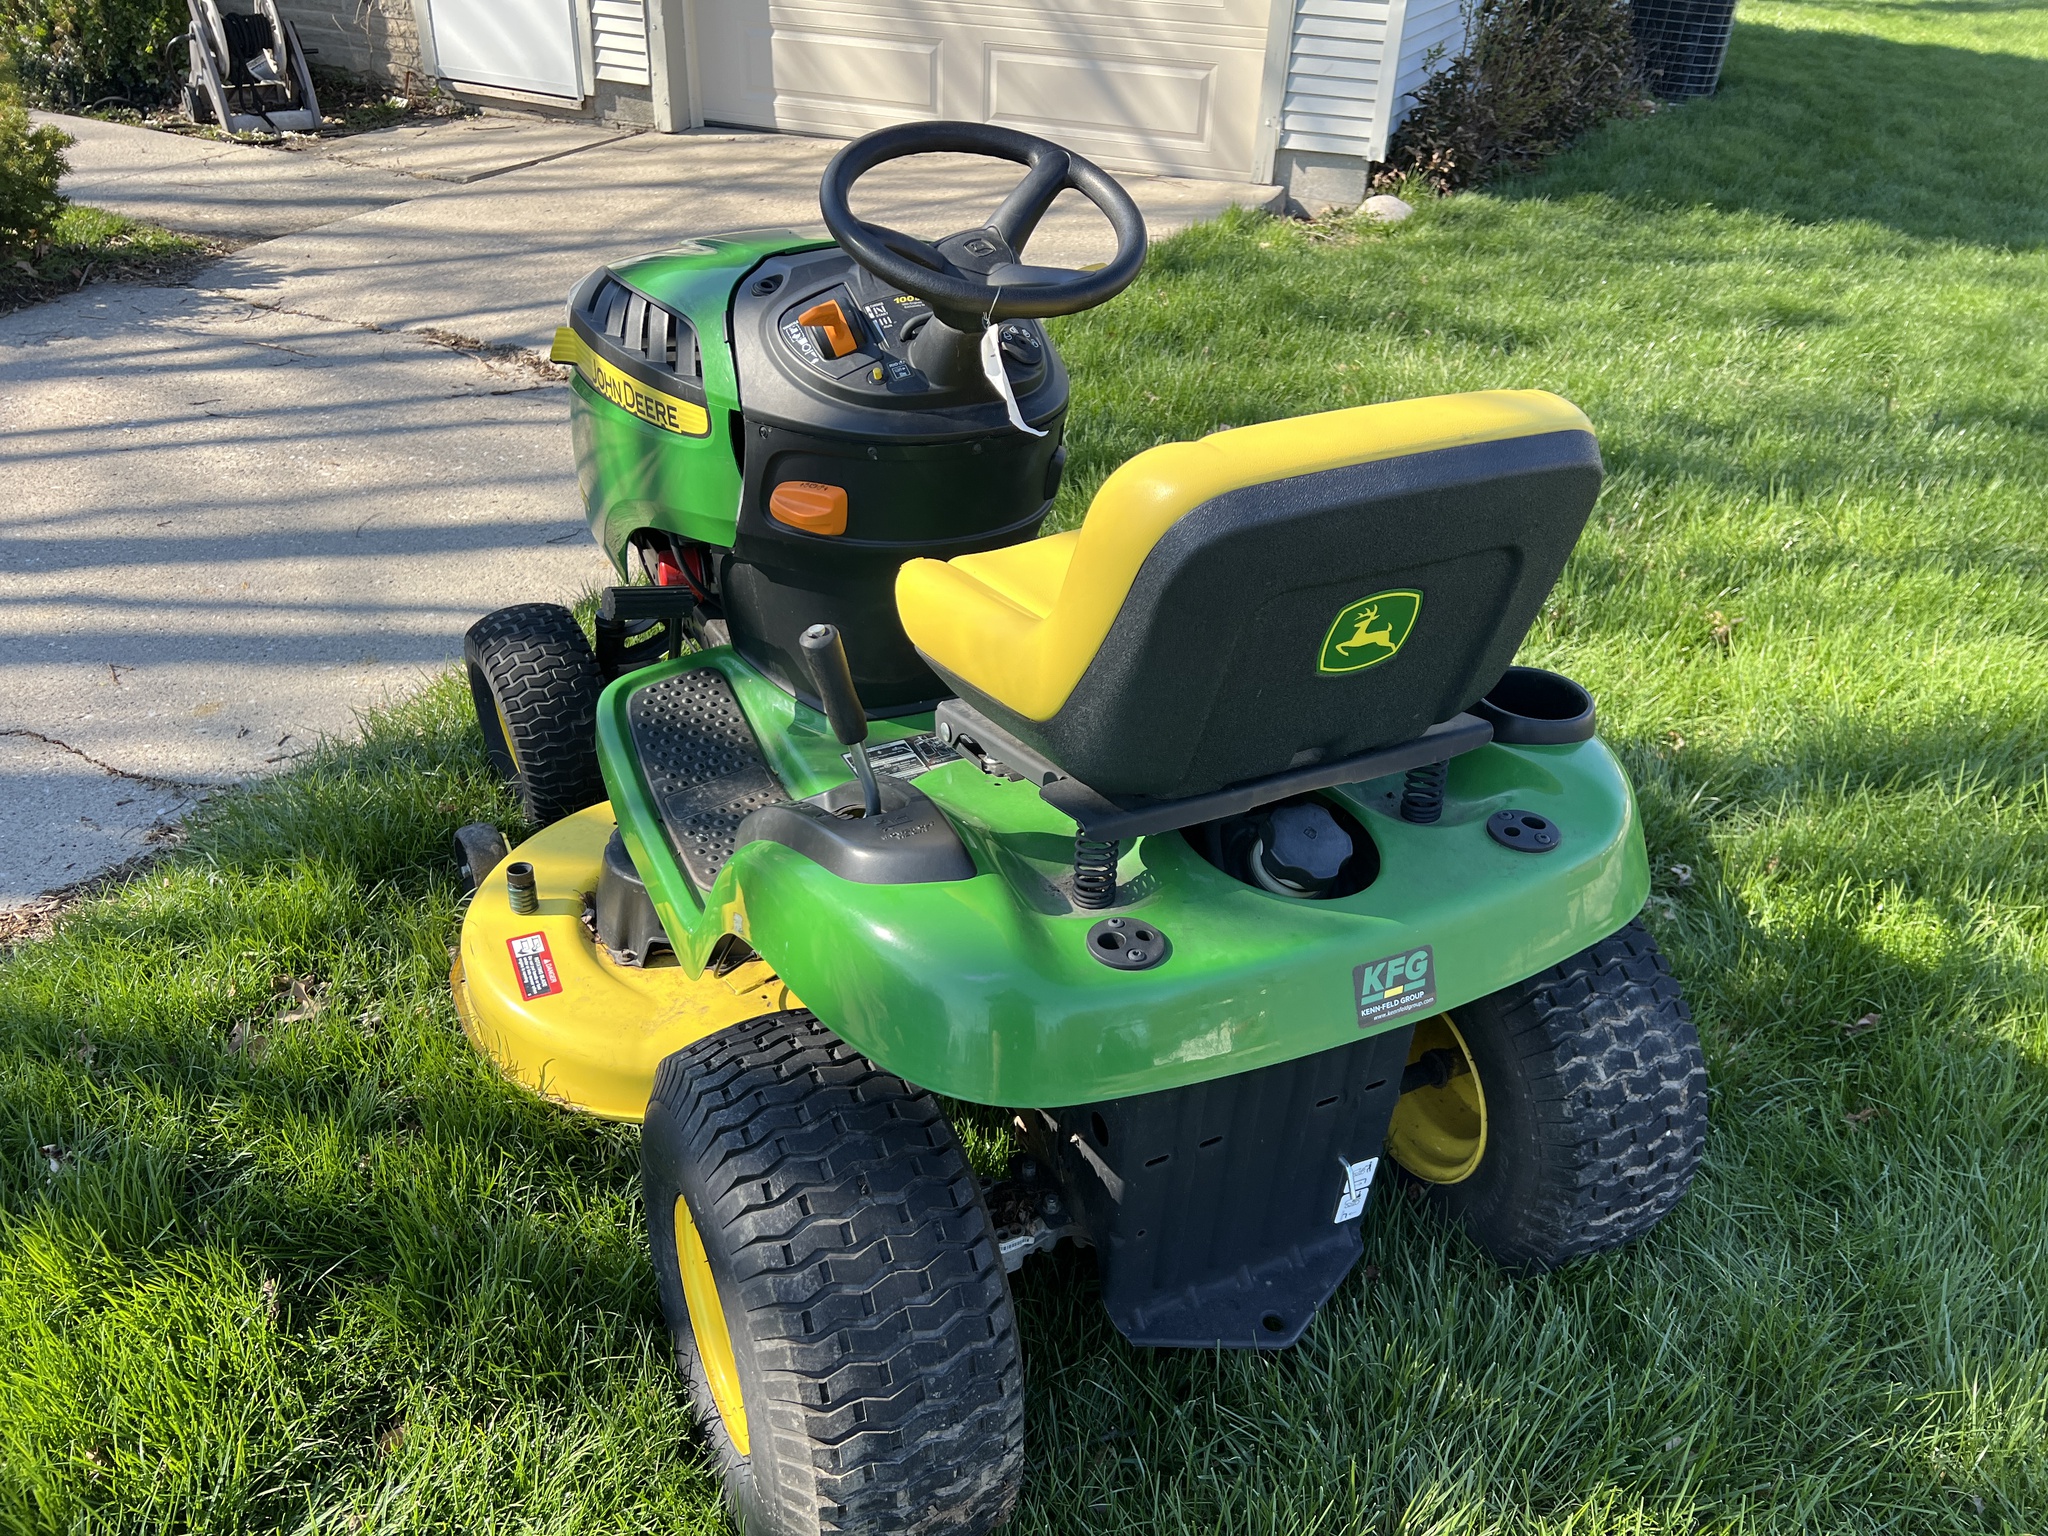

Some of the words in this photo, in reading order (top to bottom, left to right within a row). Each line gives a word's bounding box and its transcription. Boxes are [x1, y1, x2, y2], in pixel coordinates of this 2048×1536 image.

[592, 358, 622, 404] JOHN
[623, 379, 680, 429] DEERE
[545, 963, 557, 984] DANGER
[1361, 950, 1428, 996] KFG
[1361, 999, 1400, 1017] KENN-FELD
[1400, 990, 1425, 1004] GROUP
